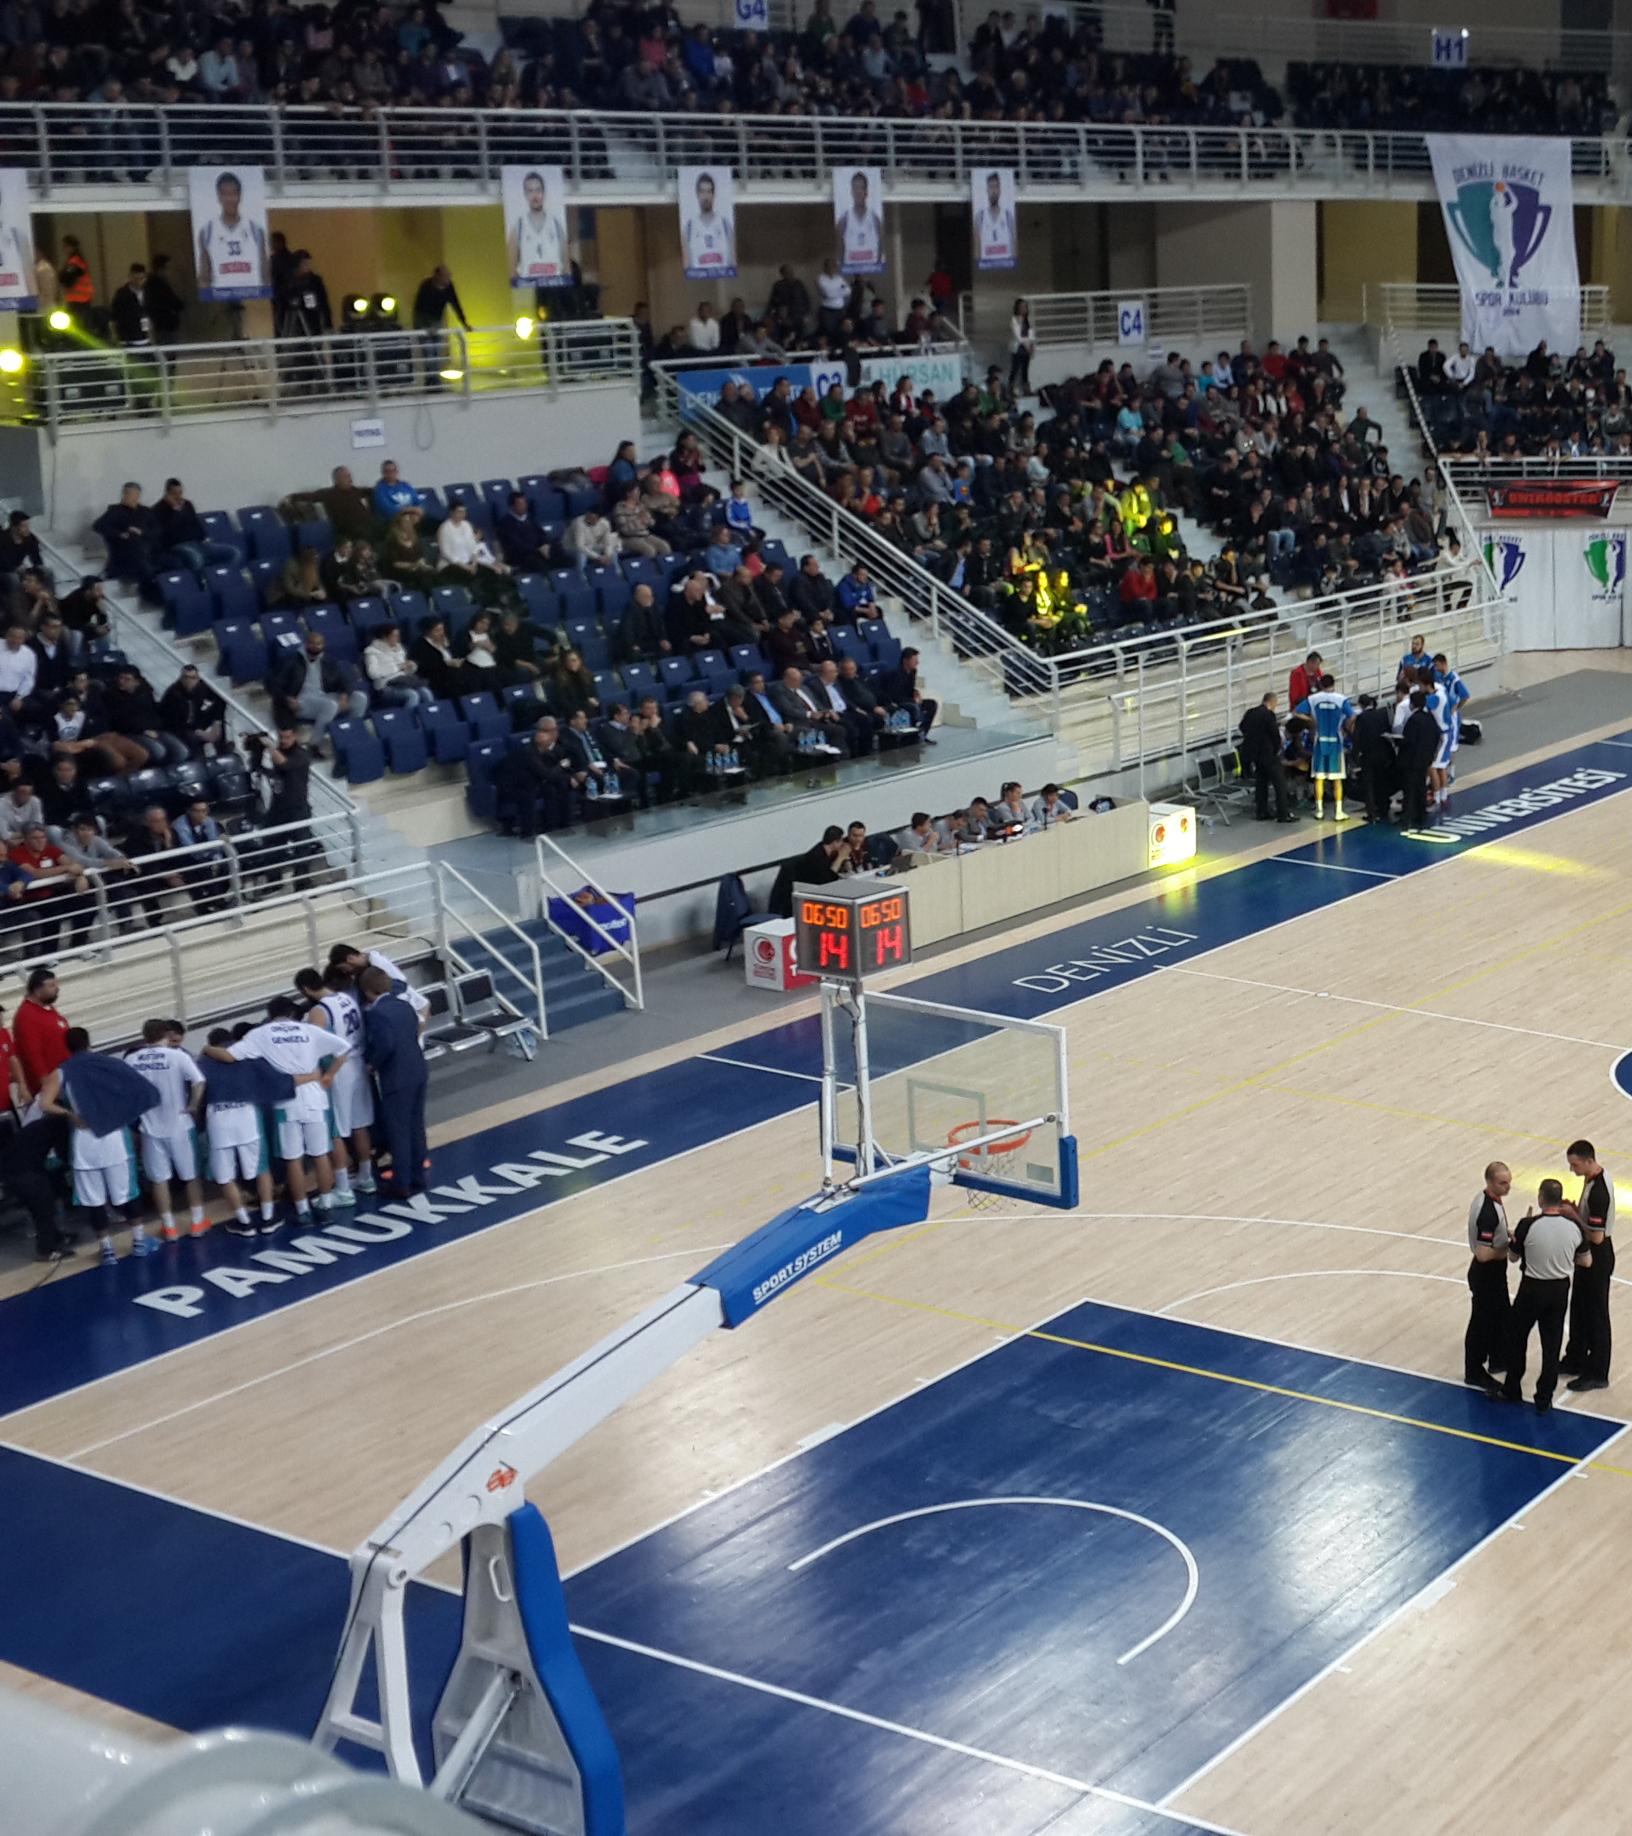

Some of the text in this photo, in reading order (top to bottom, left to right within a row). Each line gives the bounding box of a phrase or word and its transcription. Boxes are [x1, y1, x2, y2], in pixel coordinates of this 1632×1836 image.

[1435, 37, 1463, 61] H1
[1121, 310, 1142, 336] C4
[1400, 767, 1627, 843] ÜNİVERSİTESİ
[820, 931, 849, 970] 14
[876, 924, 904, 966] 14
[1012, 925, 1198, 993] DENİZLİ
[132, 1130, 649, 1319] PAMUKKALE
[752, 1229, 842, 1303] SPORT SYSTEM
